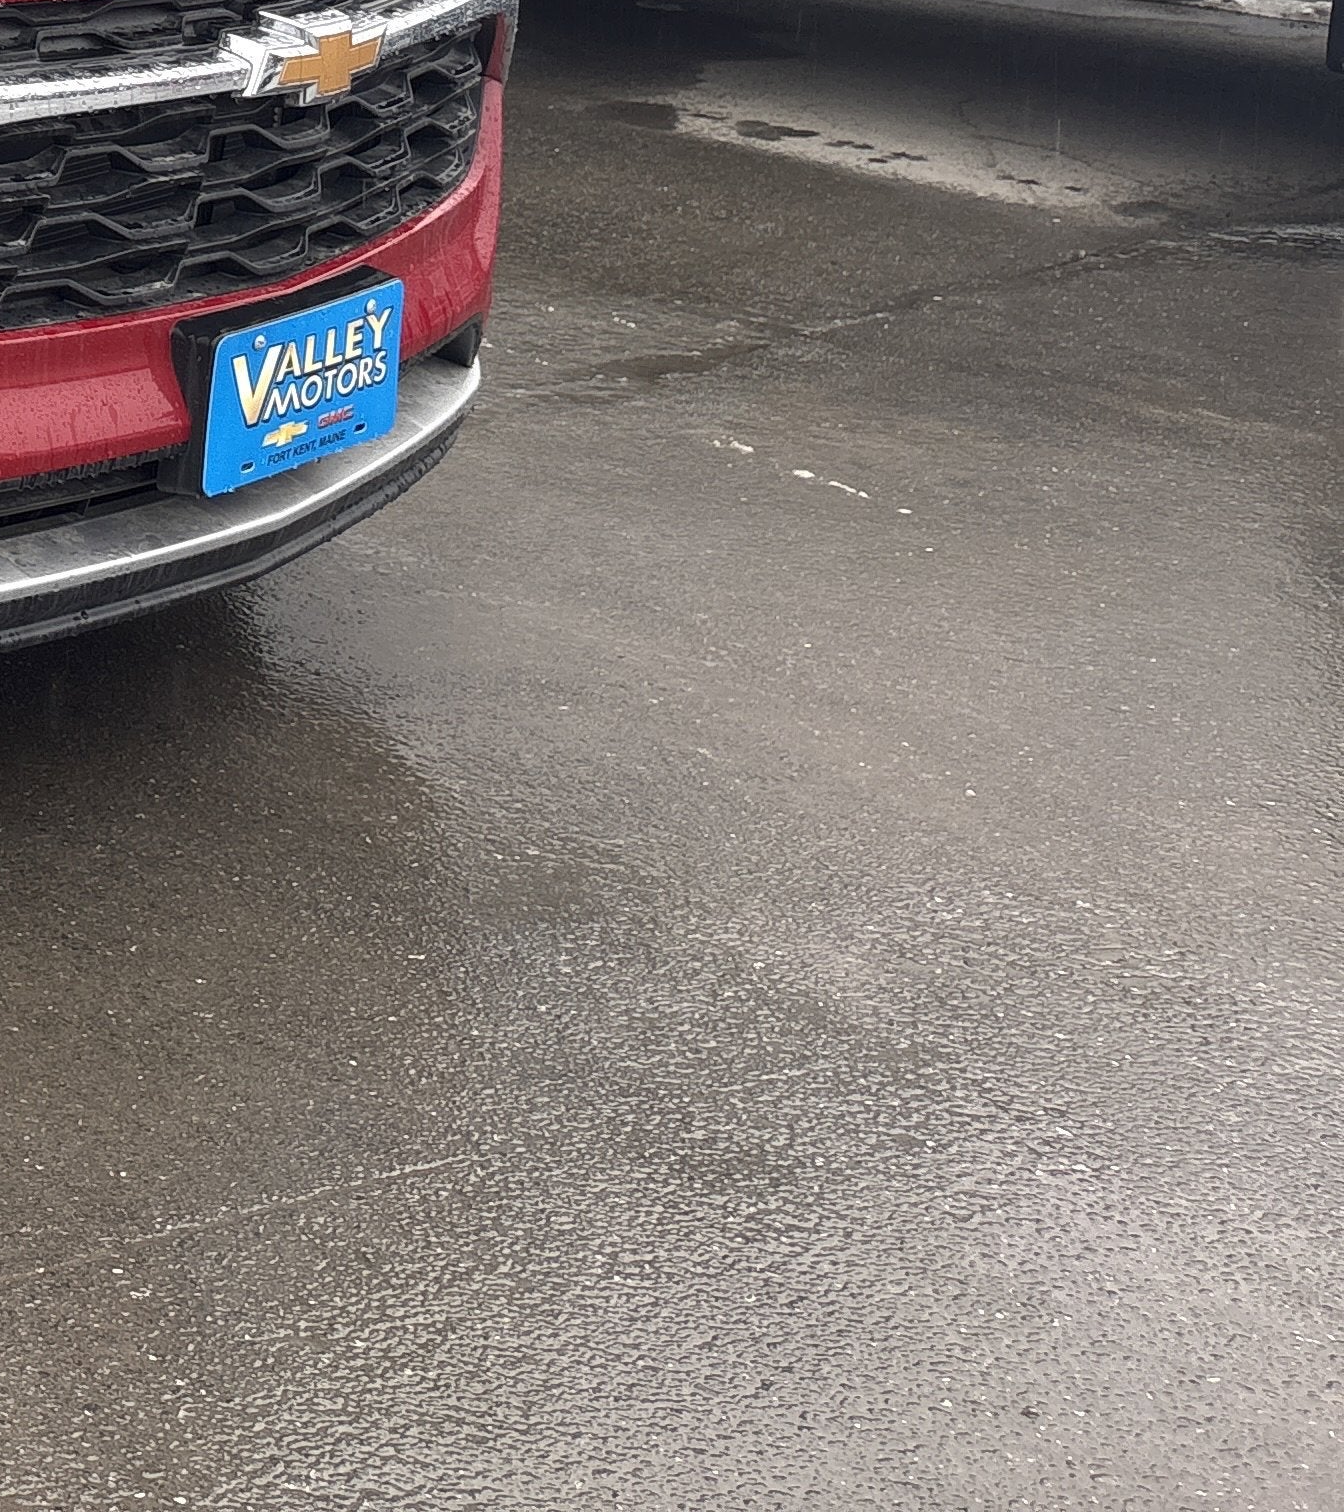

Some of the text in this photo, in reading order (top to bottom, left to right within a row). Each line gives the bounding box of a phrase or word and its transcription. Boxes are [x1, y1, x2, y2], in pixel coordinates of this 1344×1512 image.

[231, 305, 393, 427] VALLEY
[261, 350, 387, 422] MOTORS
[317, 404, 355, 429] GMC
[267, 449, 292, 466] FORT
[319, 429, 347, 447] MAINE
